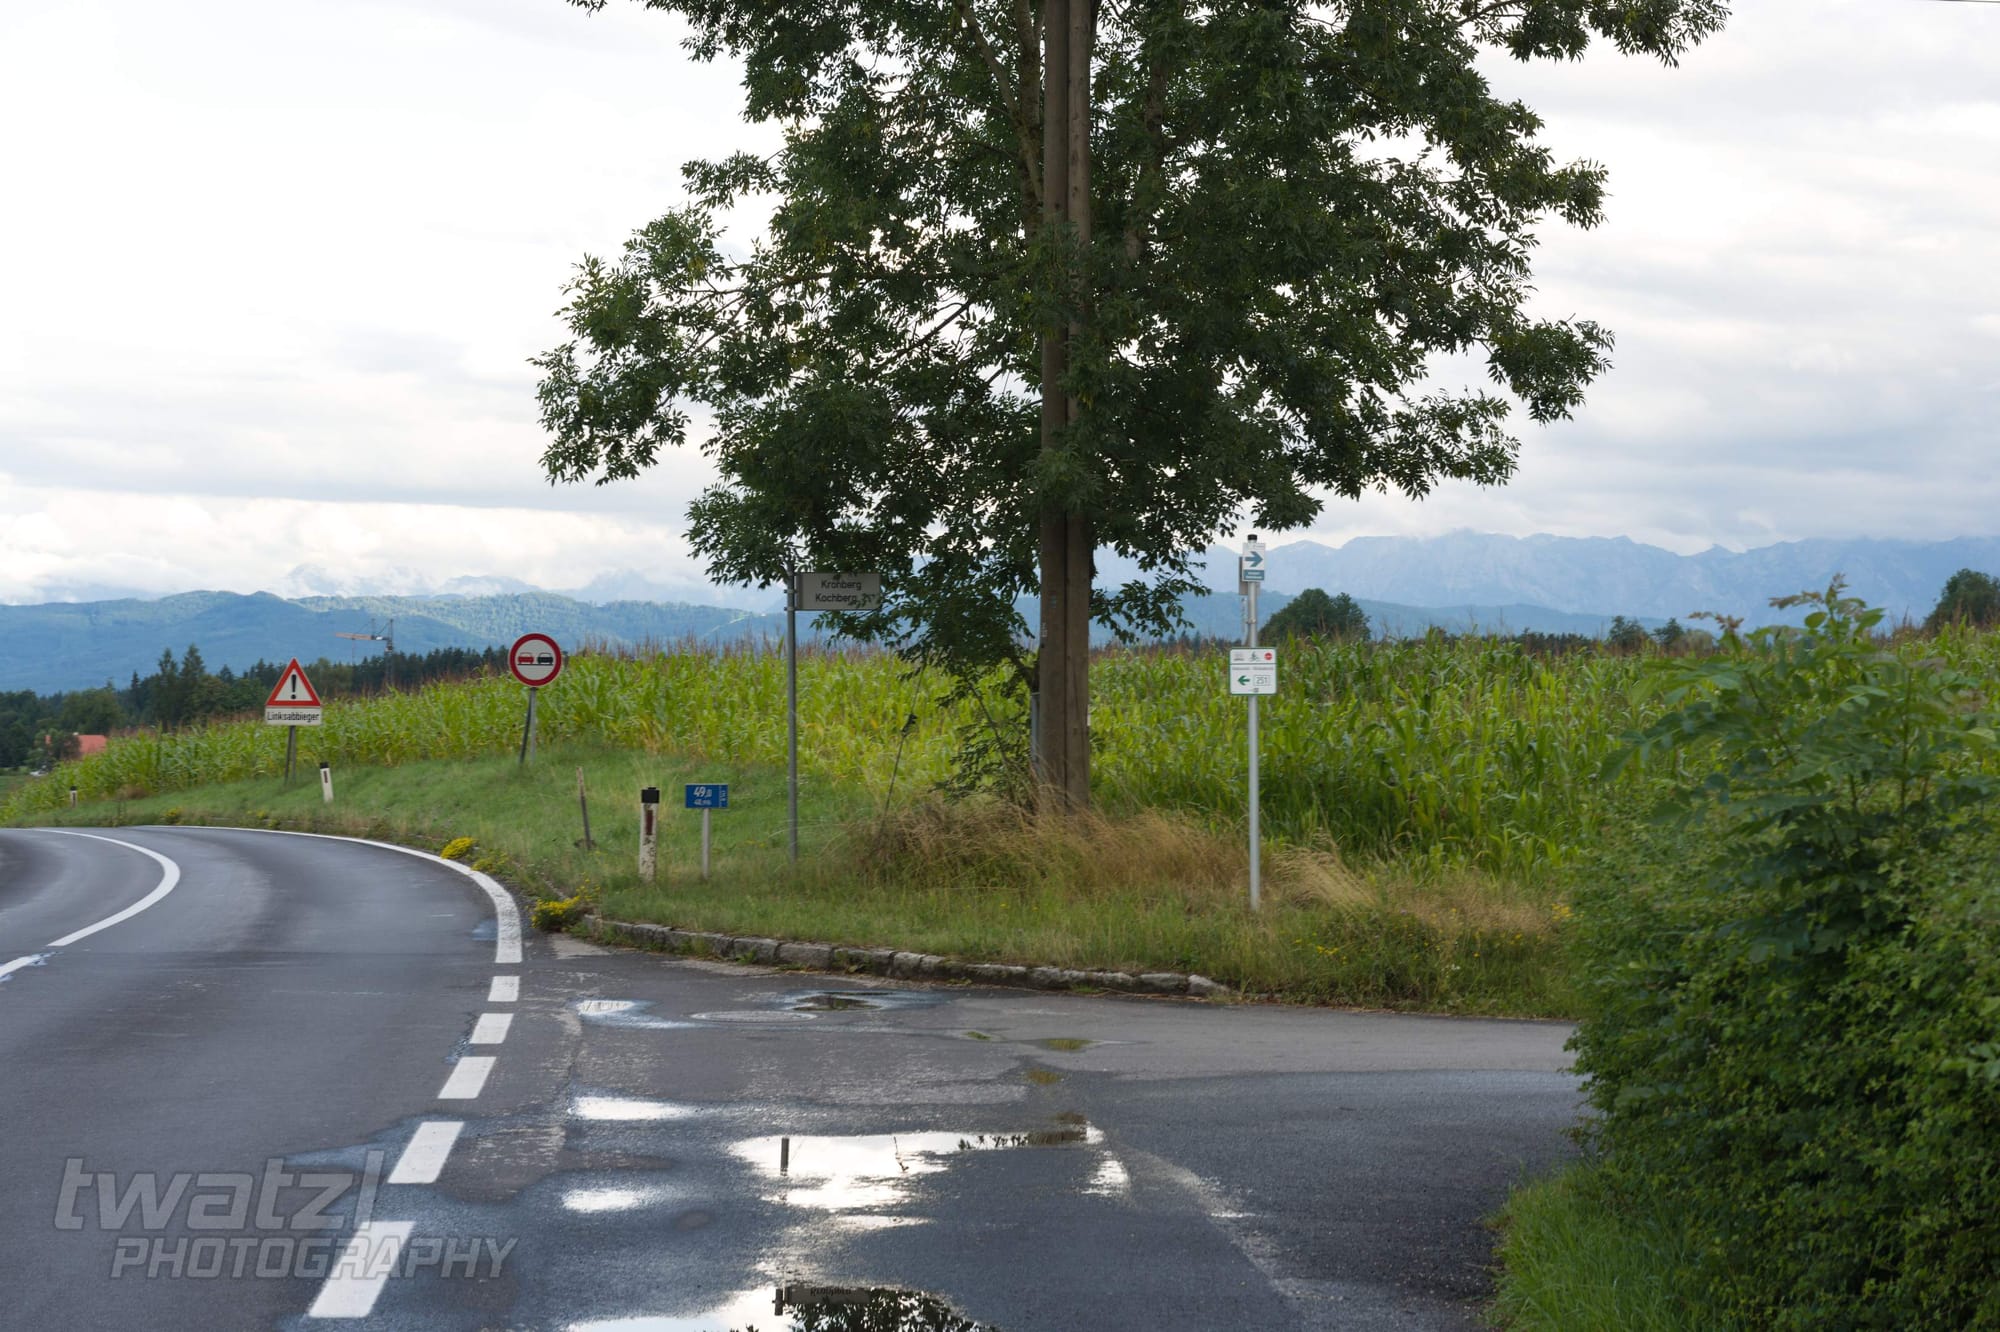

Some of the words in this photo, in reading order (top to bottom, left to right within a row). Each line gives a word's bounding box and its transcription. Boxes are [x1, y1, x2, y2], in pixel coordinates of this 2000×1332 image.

[821, 580, 862, 591] Kronberg
[815, 593, 857, 603] Kochberg
[267, 711, 320, 723] Linksabbieger
